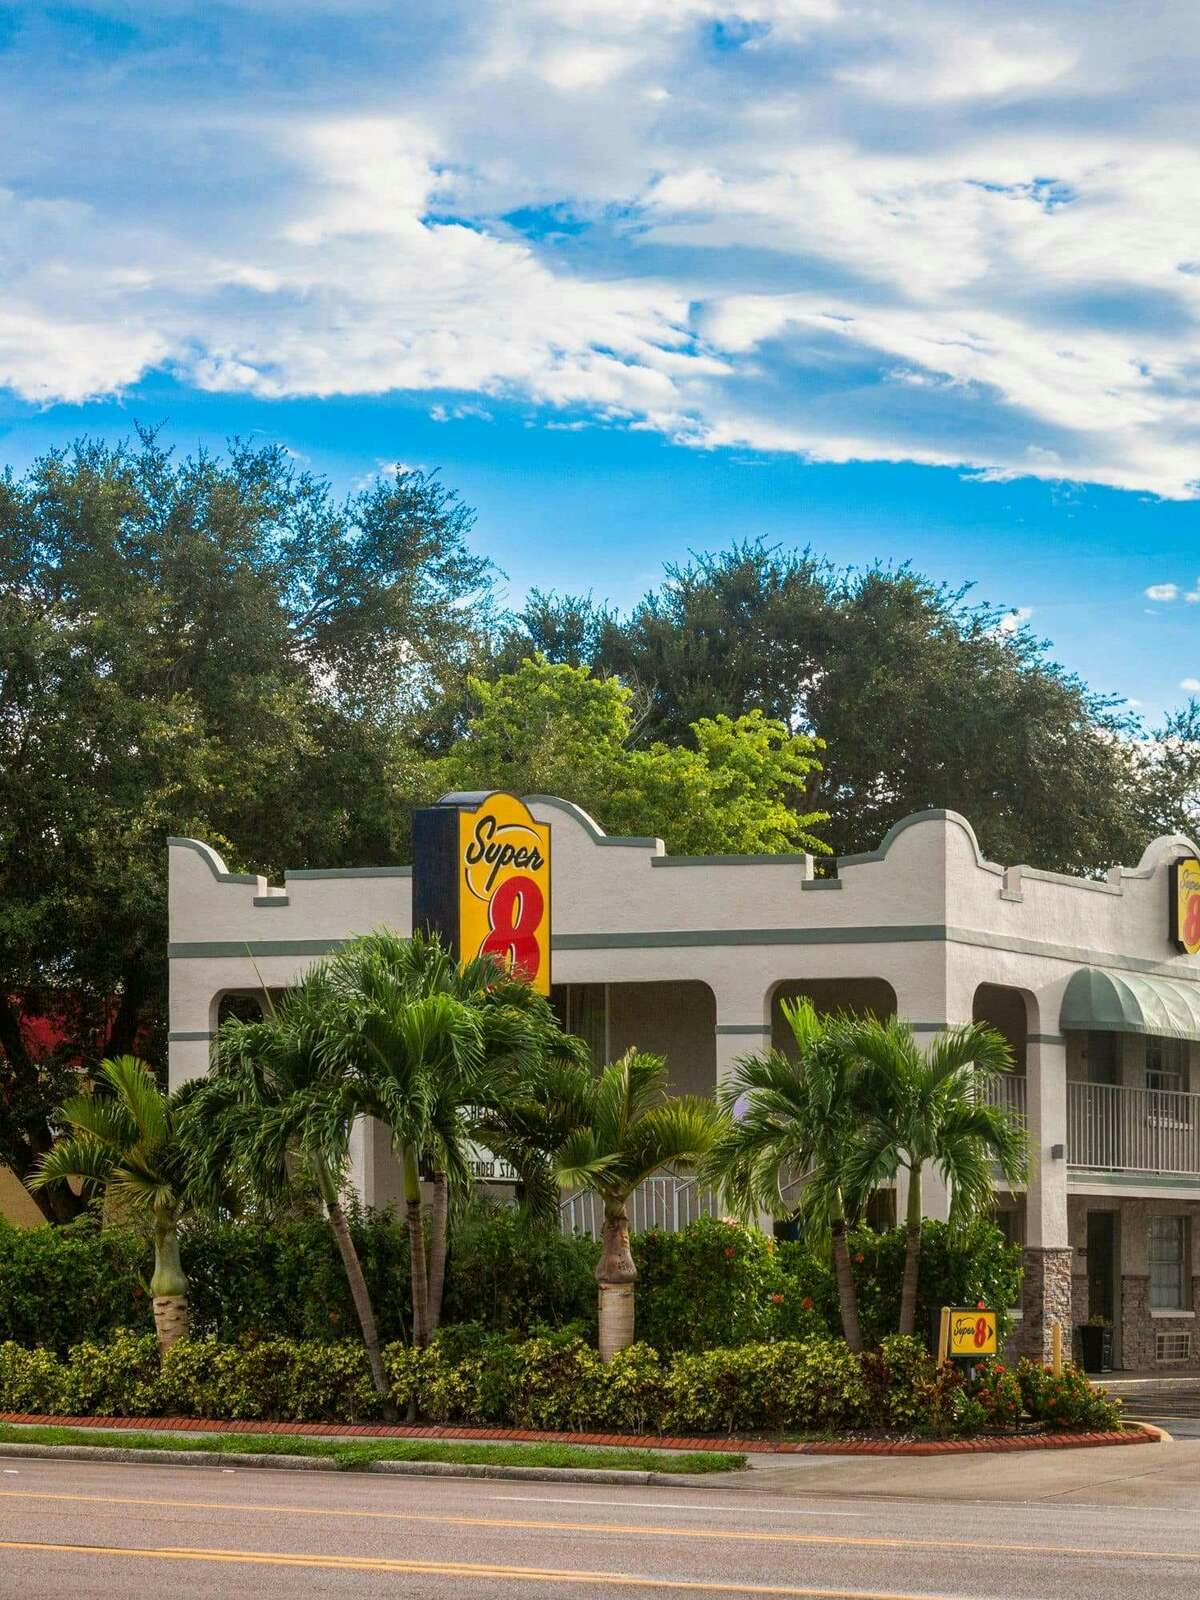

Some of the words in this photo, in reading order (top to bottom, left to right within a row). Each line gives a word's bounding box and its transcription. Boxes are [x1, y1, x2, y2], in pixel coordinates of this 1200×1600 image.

[465, 815, 545, 893] Super
[478, 876, 544, 992] 8
[953, 1318, 976, 1344] Super
[974, 1317, 987, 1348] 8
